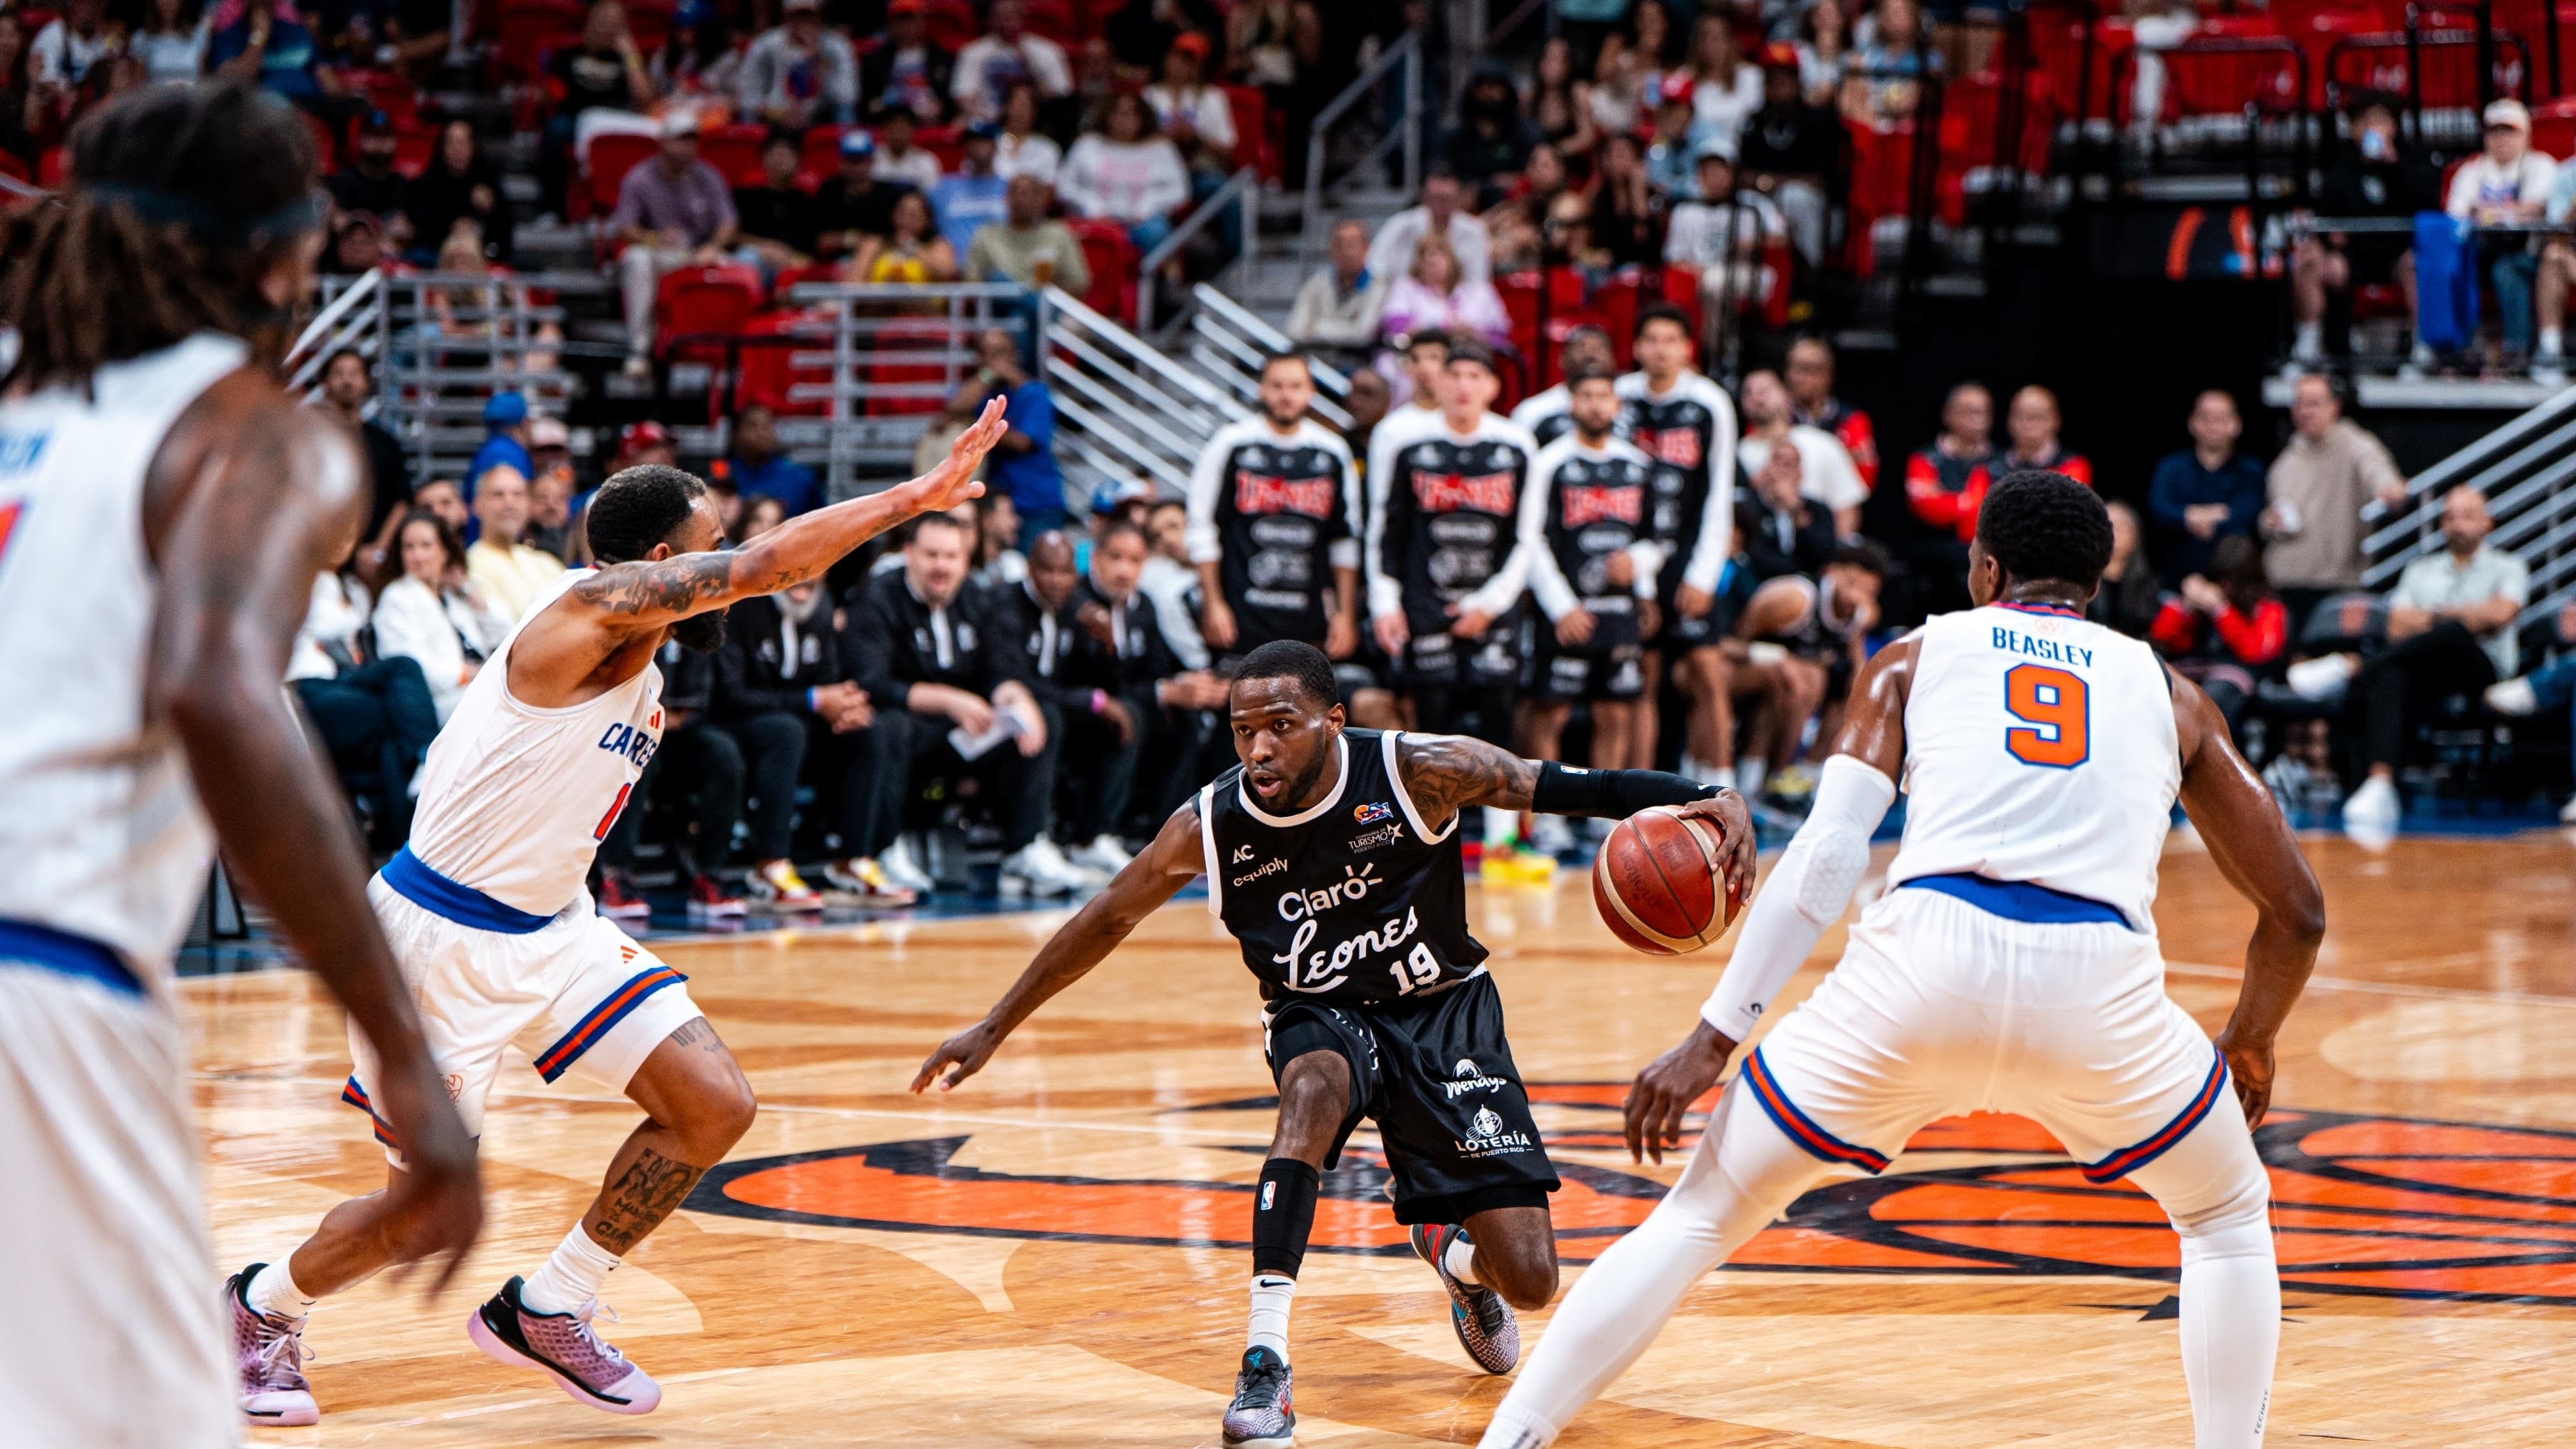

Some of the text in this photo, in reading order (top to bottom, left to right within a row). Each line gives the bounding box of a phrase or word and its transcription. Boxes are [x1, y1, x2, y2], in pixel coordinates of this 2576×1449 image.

[1992, 626, 2092, 668] BEASLEY
[2004, 663, 2090, 771] 9
[1233, 844, 1255, 864] AC
[1348, 832, 1388, 849] TURISMO
[1354, 845, 1375, 854] PUERTO
[1233, 857, 1288, 887] equiply
[1278, 877, 1367, 922] Claro
[1272, 905, 1418, 994] Leones
[1389, 942, 1441, 997] 19
[1455, 1131, 1531, 1152] LOTERÍA
[1481, 1148, 1509, 1157] PUERTO
[2254, 1390, 2268, 1435] TECHFIT
